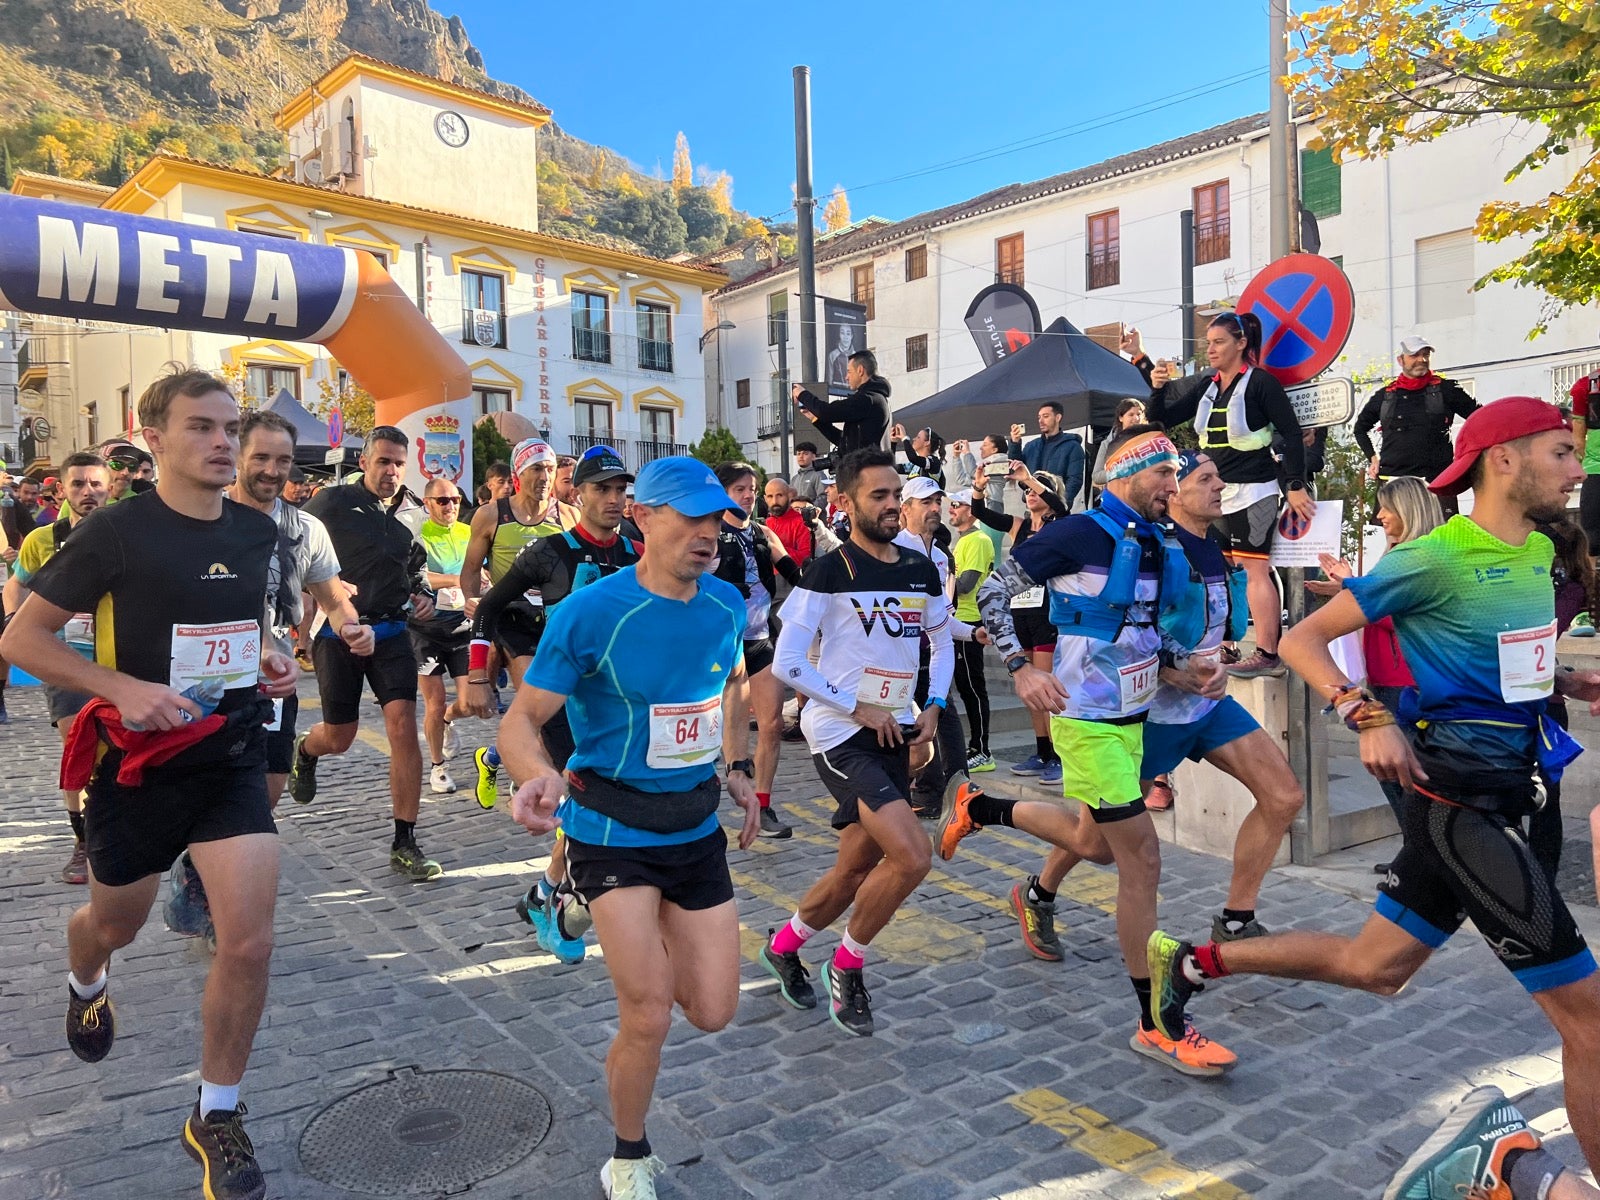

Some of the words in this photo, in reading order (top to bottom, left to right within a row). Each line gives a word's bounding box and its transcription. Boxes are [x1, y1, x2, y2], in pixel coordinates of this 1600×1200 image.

[37, 214, 299, 327] META
[538, 346, 551, 430] SIERRA
[204, 639, 231, 667] 73
[1534, 644, 1545, 672] 2
[880, 680, 892, 699] 5
[1132, 671, 1149, 693] 141
[675, 717, 700, 745] 64
[1479, 1120, 1524, 1142] SCARPA
